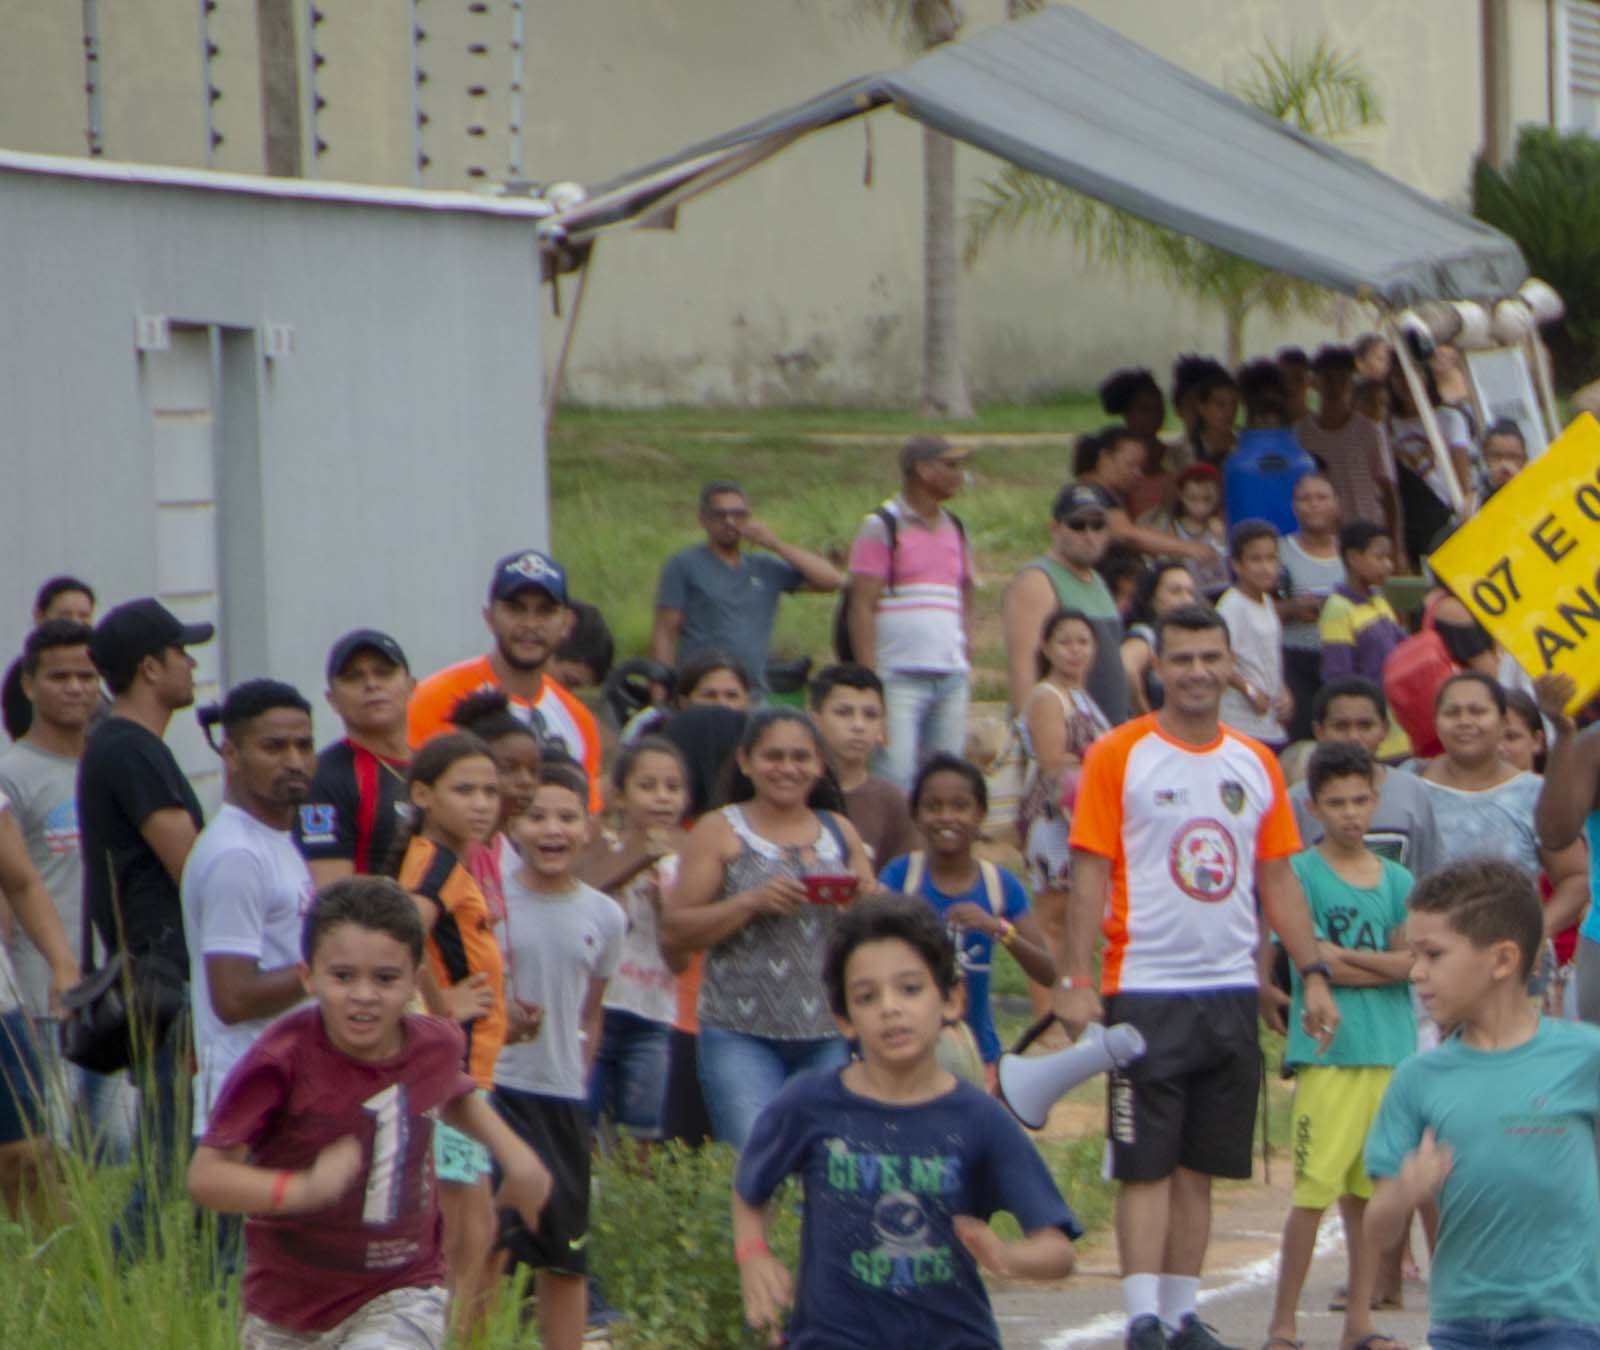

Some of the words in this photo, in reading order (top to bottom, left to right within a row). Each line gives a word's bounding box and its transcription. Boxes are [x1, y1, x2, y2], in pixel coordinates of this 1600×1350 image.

[1472, 557, 1521, 616] 07
[1530, 514, 1579, 563] E
[828, 1150, 900, 1193] GIVE
[850, 1247, 953, 1288] SPACE
